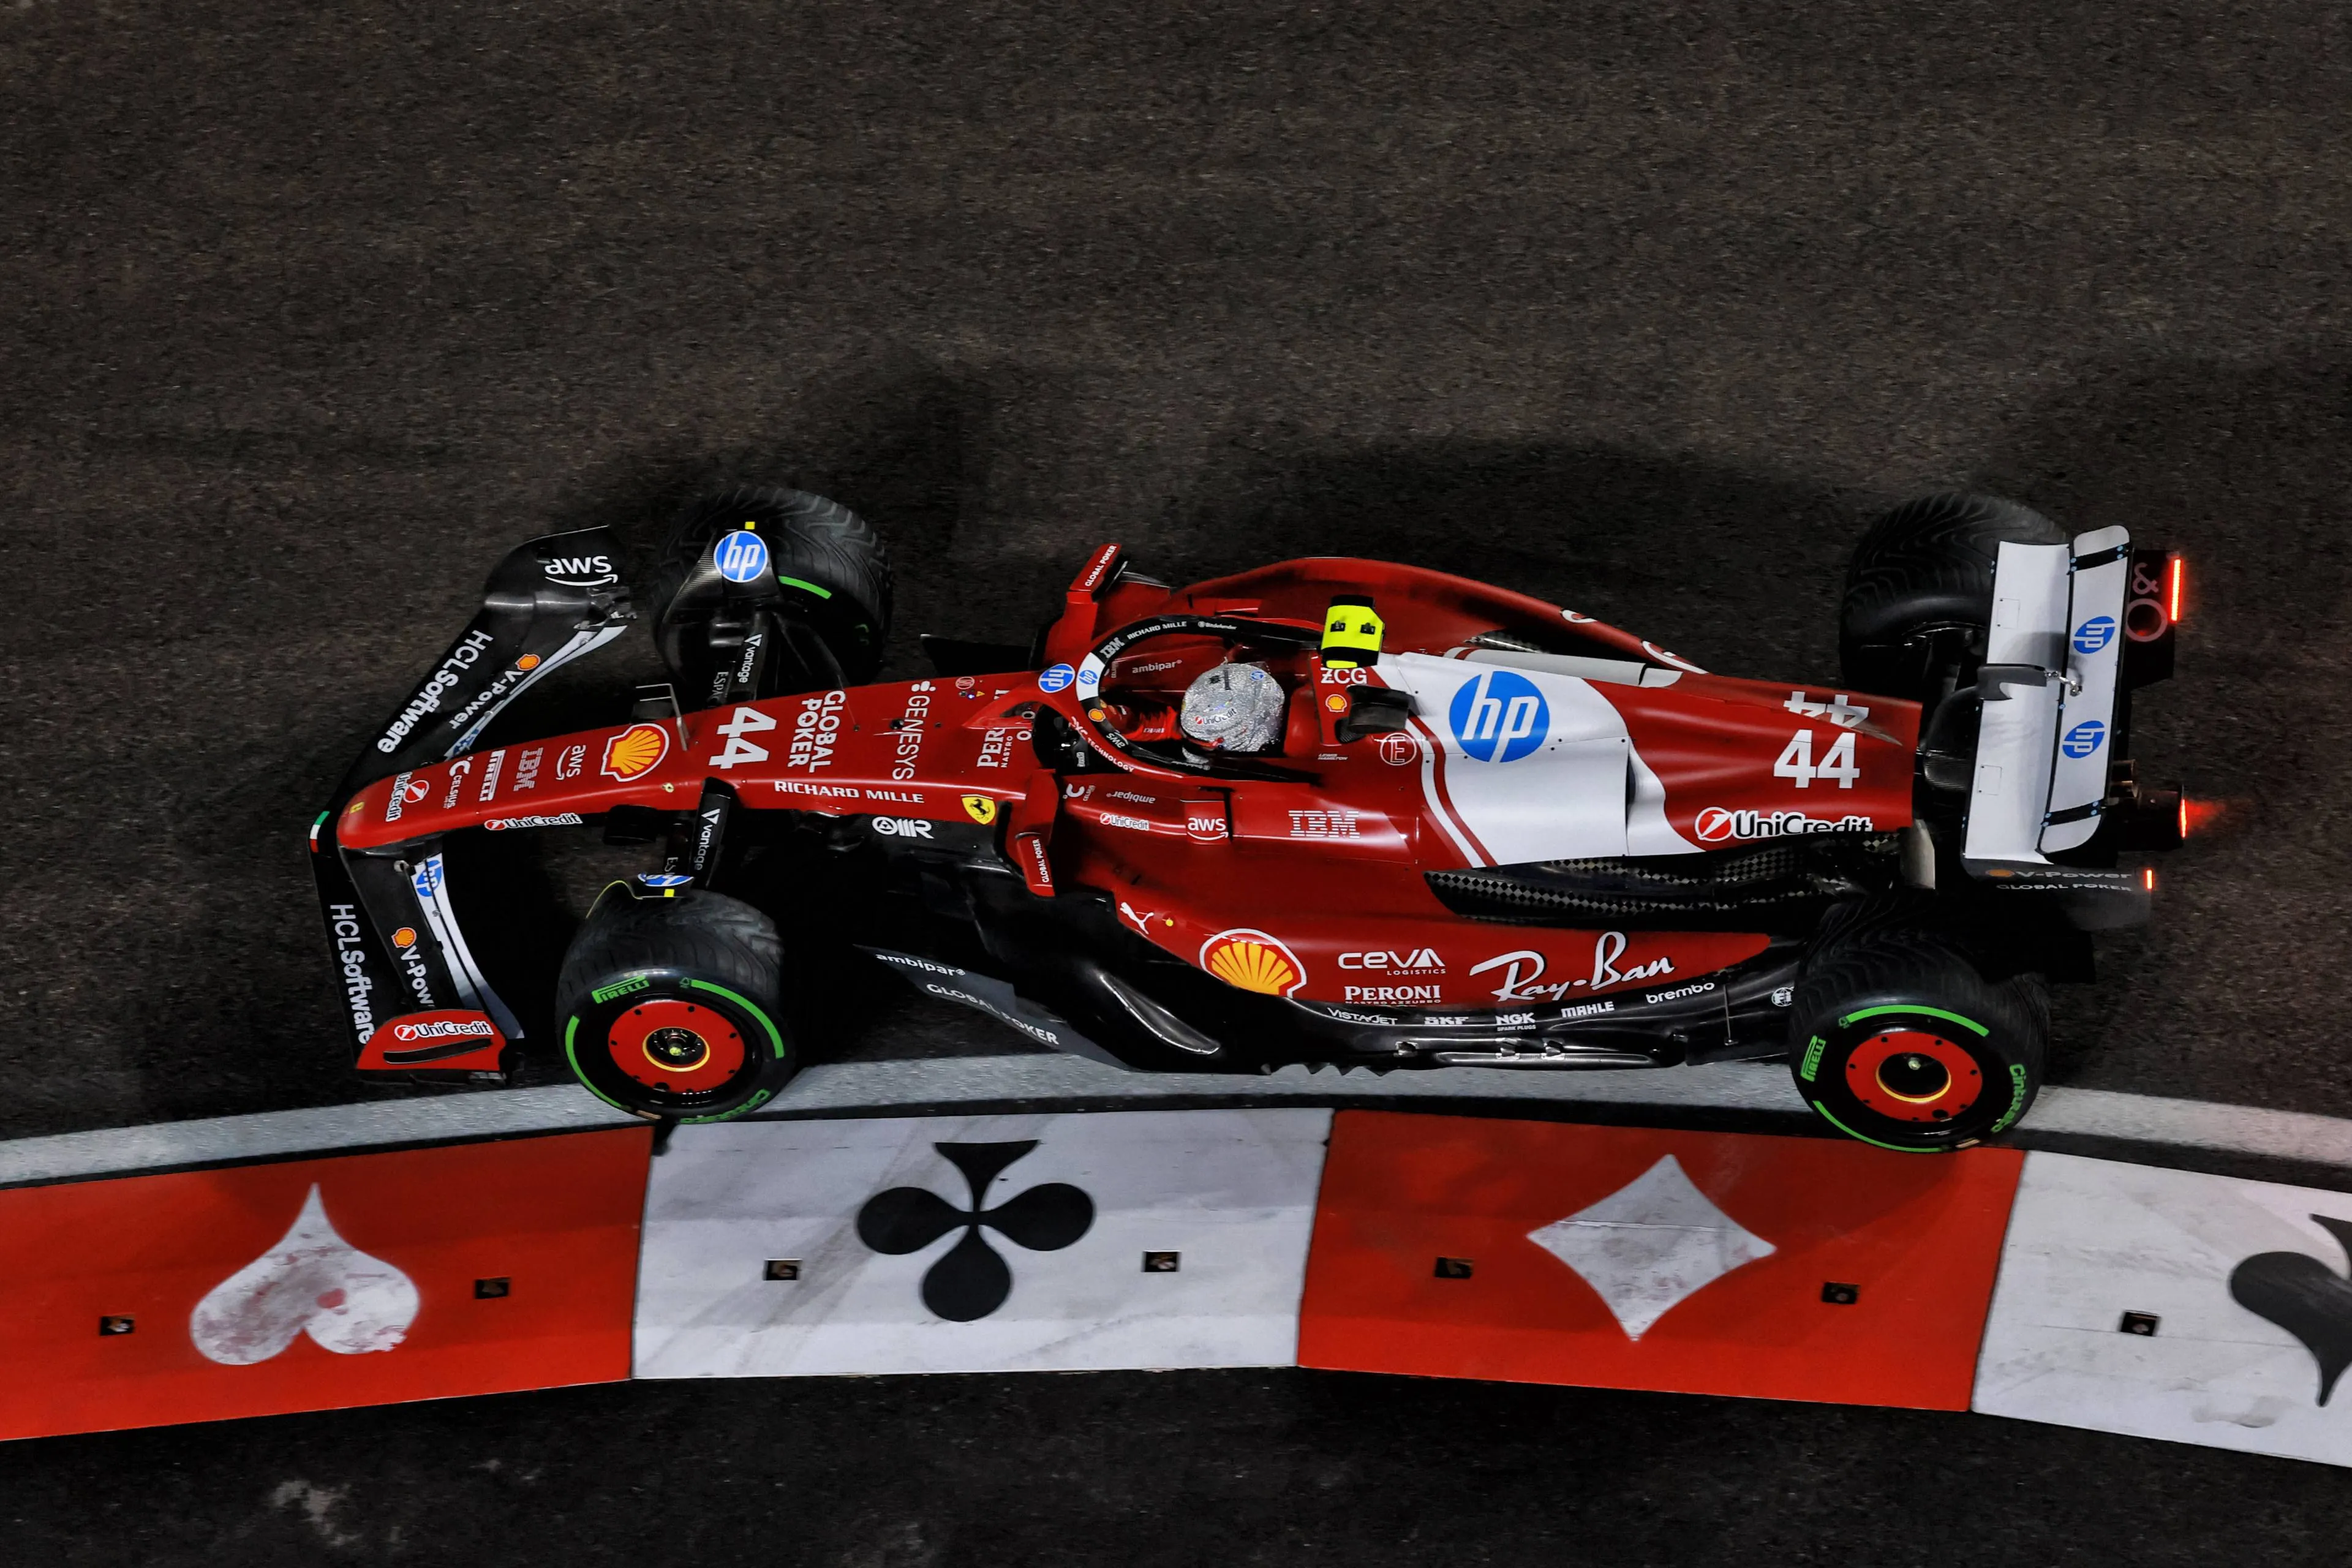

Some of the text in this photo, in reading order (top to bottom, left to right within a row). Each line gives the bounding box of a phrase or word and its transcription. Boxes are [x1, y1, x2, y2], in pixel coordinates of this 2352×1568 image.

[545, 555, 612, 575] aws
[719, 531, 763, 582] hp
[1085, 545, 1117, 587] GLOBAL POKER
[1100, 637, 1125, 658] IBM
[1127, 625, 1161, 640] RICHARD
[2074, 620, 2115, 650] hp
[738, 646, 755, 684] vantage
[1039, 666, 1075, 689] hp
[1079, 670, 1098, 685] hp
[1132, 660, 1177, 674] ambipar
[1321, 667, 1368, 684] ZCG
[377, 630, 494, 753] HCLSoftware
[449, 670, 524, 729] V-Power
[1202, 708, 1238, 726] UniCredit
[1460, 671, 1540, 763] hp
[1784, 691, 1870, 728] 44
[709, 706, 777, 769] 44
[788, 698, 823, 767] POKER
[809, 690, 846, 773] GLOBAL
[892, 695, 930, 780] GENESYS
[1106, 732, 1126, 749] aws
[2063, 725, 2105, 755] hp
[566, 744, 587, 778] aws
[1000, 736, 1013, 768] NASTRO
[1087, 737, 1135, 772] TECHNOLOGY
[1774, 729, 1861, 789] 44
[479, 749, 506, 802] PIRELLI
[513, 747, 544, 791] IBM
[385, 771, 413, 822] UniCredit
[447, 775, 462, 809] CELSIUS
[774, 780, 925, 804] RICHARD MILLE
[1113, 791, 1156, 804] ambipar
[505, 812, 583, 828] UniCredit
[1110, 815, 1150, 831] UniCredit
[1188, 816, 1226, 832] aws
[1288, 810, 1360, 839] IBM
[1733, 809, 1874, 840] UniCredit
[694, 824, 714, 871] vantage
[1033, 839, 1050, 883] GLOBAL POKER
[416, 861, 442, 895] hp
[330, 904, 375, 1045] HCLSoftware
[875, 953, 957, 976] ambipar
[592, 974, 650, 1004] PIRELLI
[1344, 985, 1441, 1001] PERONI
[1646, 982, 1715, 1004] brembo
[925, 984, 1060, 1044] GLOBAL POKER
[1424, 1016, 1469, 1025] SKF
[1495, 1012, 1536, 1025] NGK
[1561, 1001, 1615, 1018] MAHLE
[415, 1021, 494, 1039] UniCredit
[1800, 1035, 1826, 1082] PIRELLI
